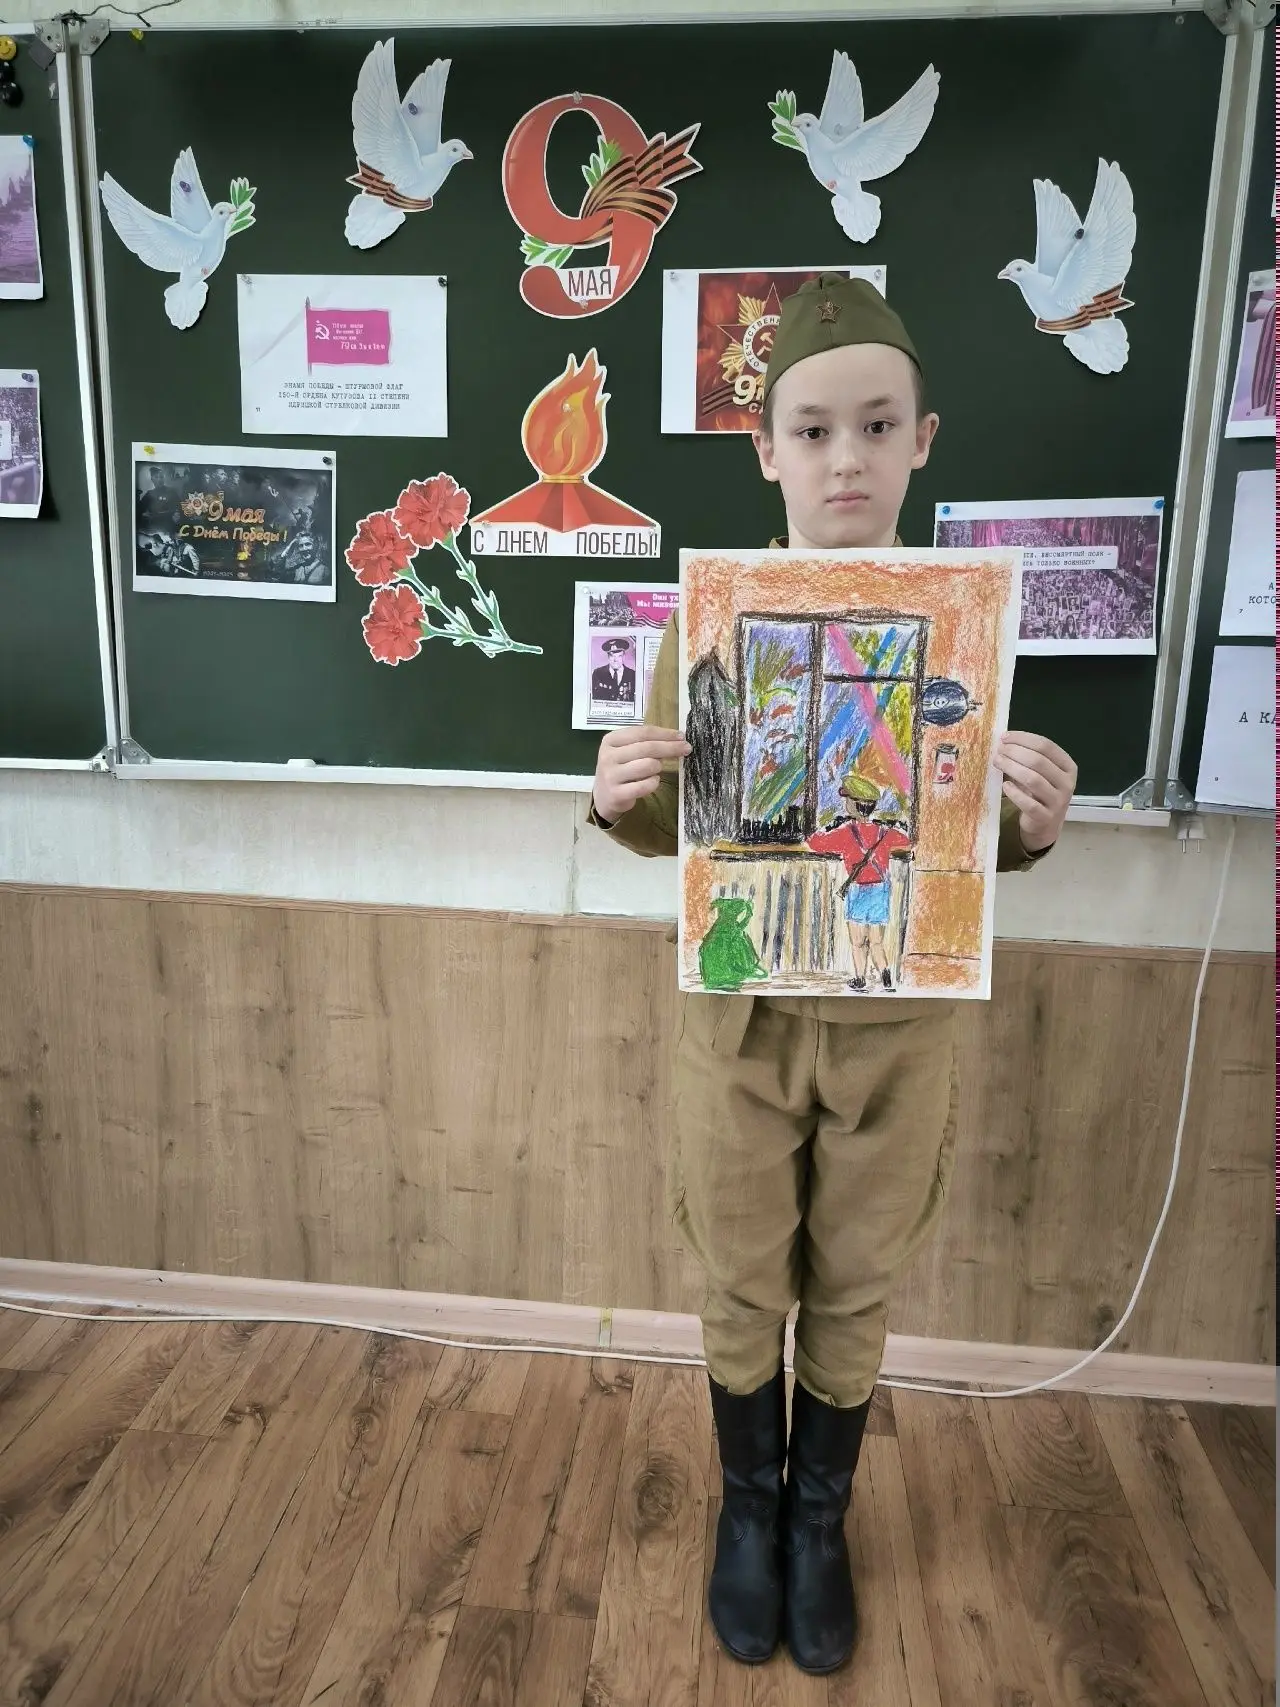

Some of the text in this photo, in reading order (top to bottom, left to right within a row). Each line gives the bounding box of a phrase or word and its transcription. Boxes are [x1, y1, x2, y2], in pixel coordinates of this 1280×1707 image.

[503, 94, 657, 318] 9
[567, 268, 613, 297] МАЯ
[308, 382, 334, 390] ПОБЕДЫ
[344, 382, 383, 390] ШТУРМОВОЙ
[331, 392, 365, 400] КУТУЗОВА
[288, 401, 322, 409] ИДРИЦКОЙ
[325, 402, 367, 410] СТРЕЛКОВОЙ
[207, 499, 266, 523] 9 мая
[179, 524, 190, 537] С
[192, 525, 229, 539] Днём
[473, 529, 658, 556] С ДНЕМ ПОБЕДЫ!
[1268, 582, 1275, 590] А
[1238, 711, 1249, 723] А
